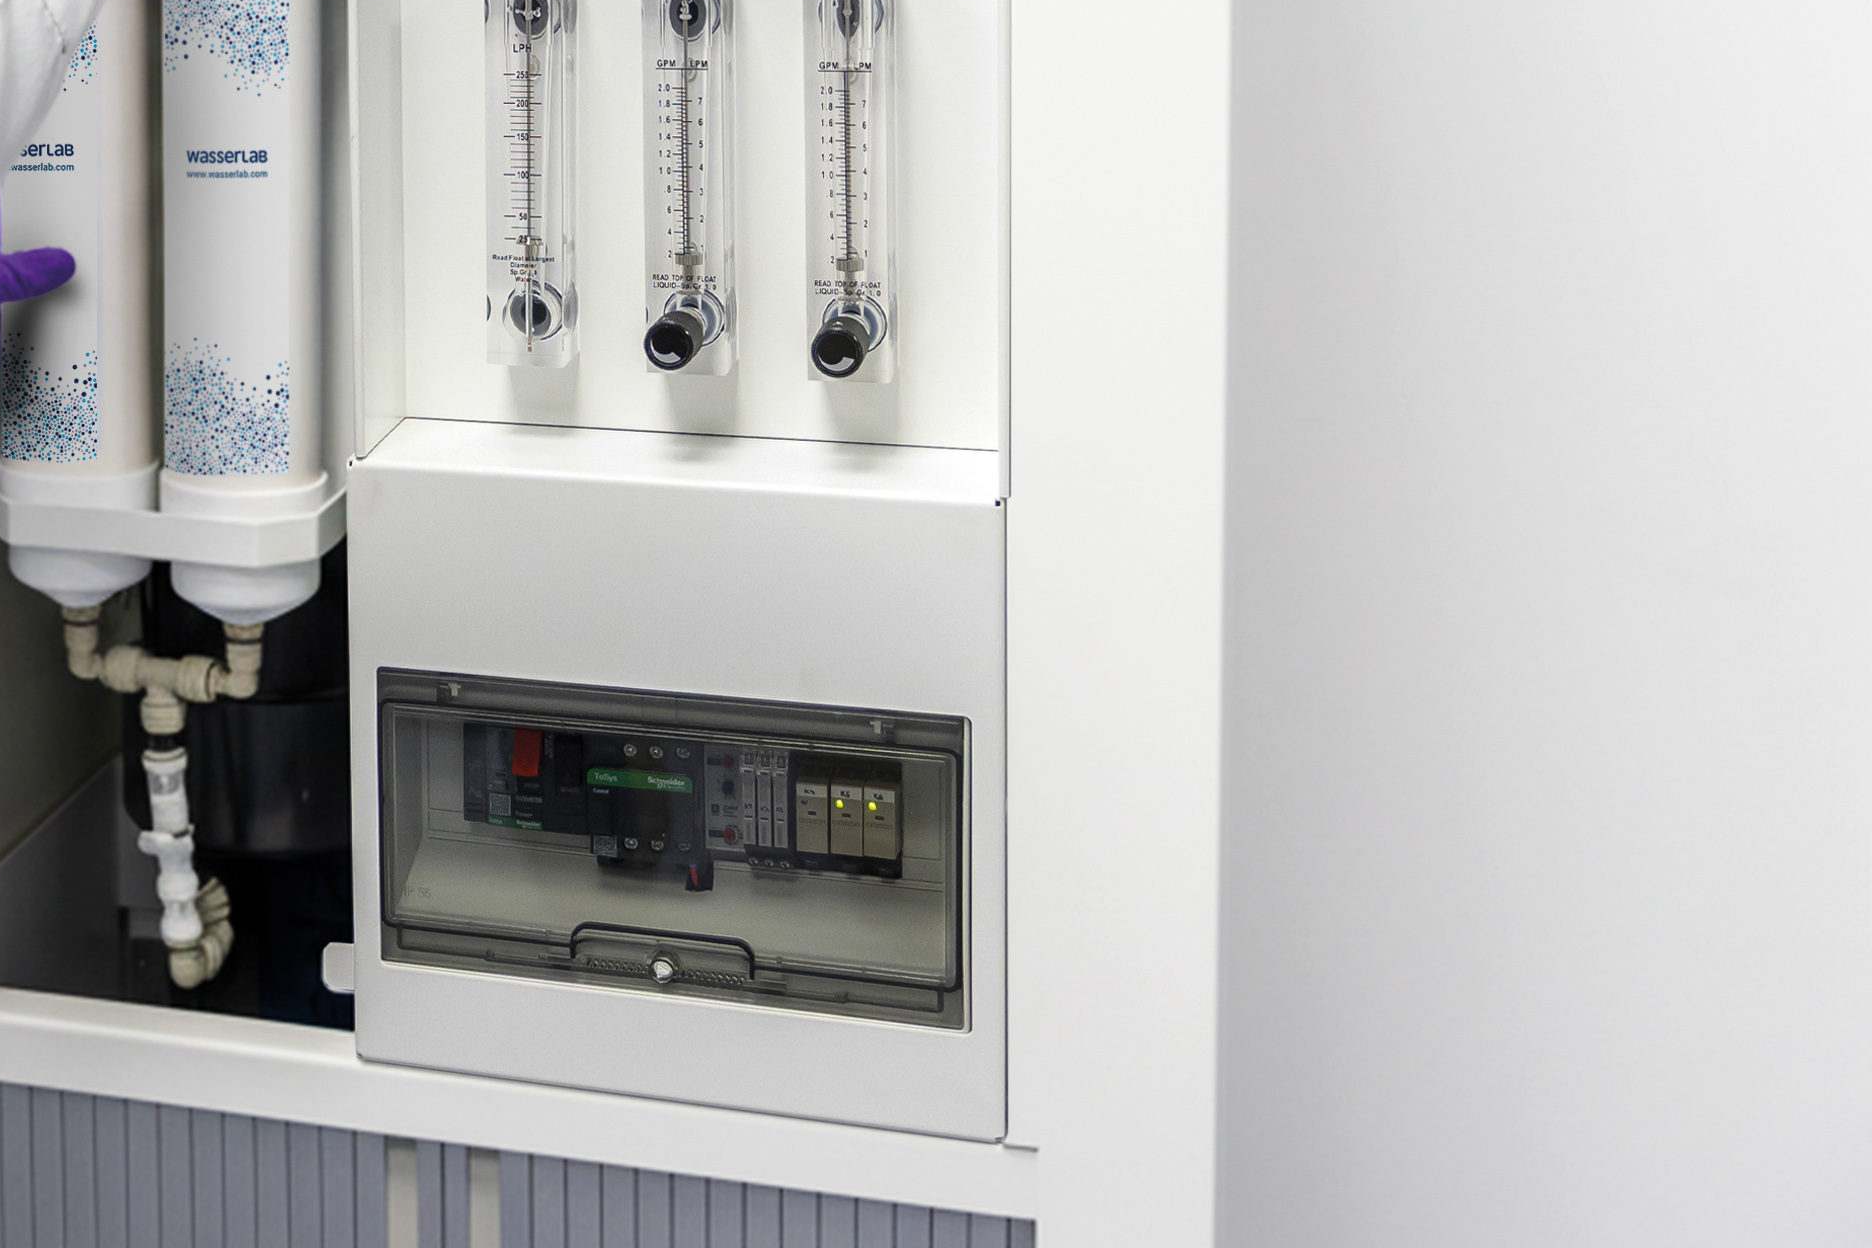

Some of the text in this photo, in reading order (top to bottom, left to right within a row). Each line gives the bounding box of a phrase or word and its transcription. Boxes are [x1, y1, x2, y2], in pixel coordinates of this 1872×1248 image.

[513, 44, 532, 53] LPH
[657, 59, 676, 67] GPM
[819, 61, 839, 69] GPM
[9, 162, 75, 171] .wasserlab.com
[186, 169, 268, 178] www.wasserlab.com
[594, 772, 685, 789] TeSys Schneider
